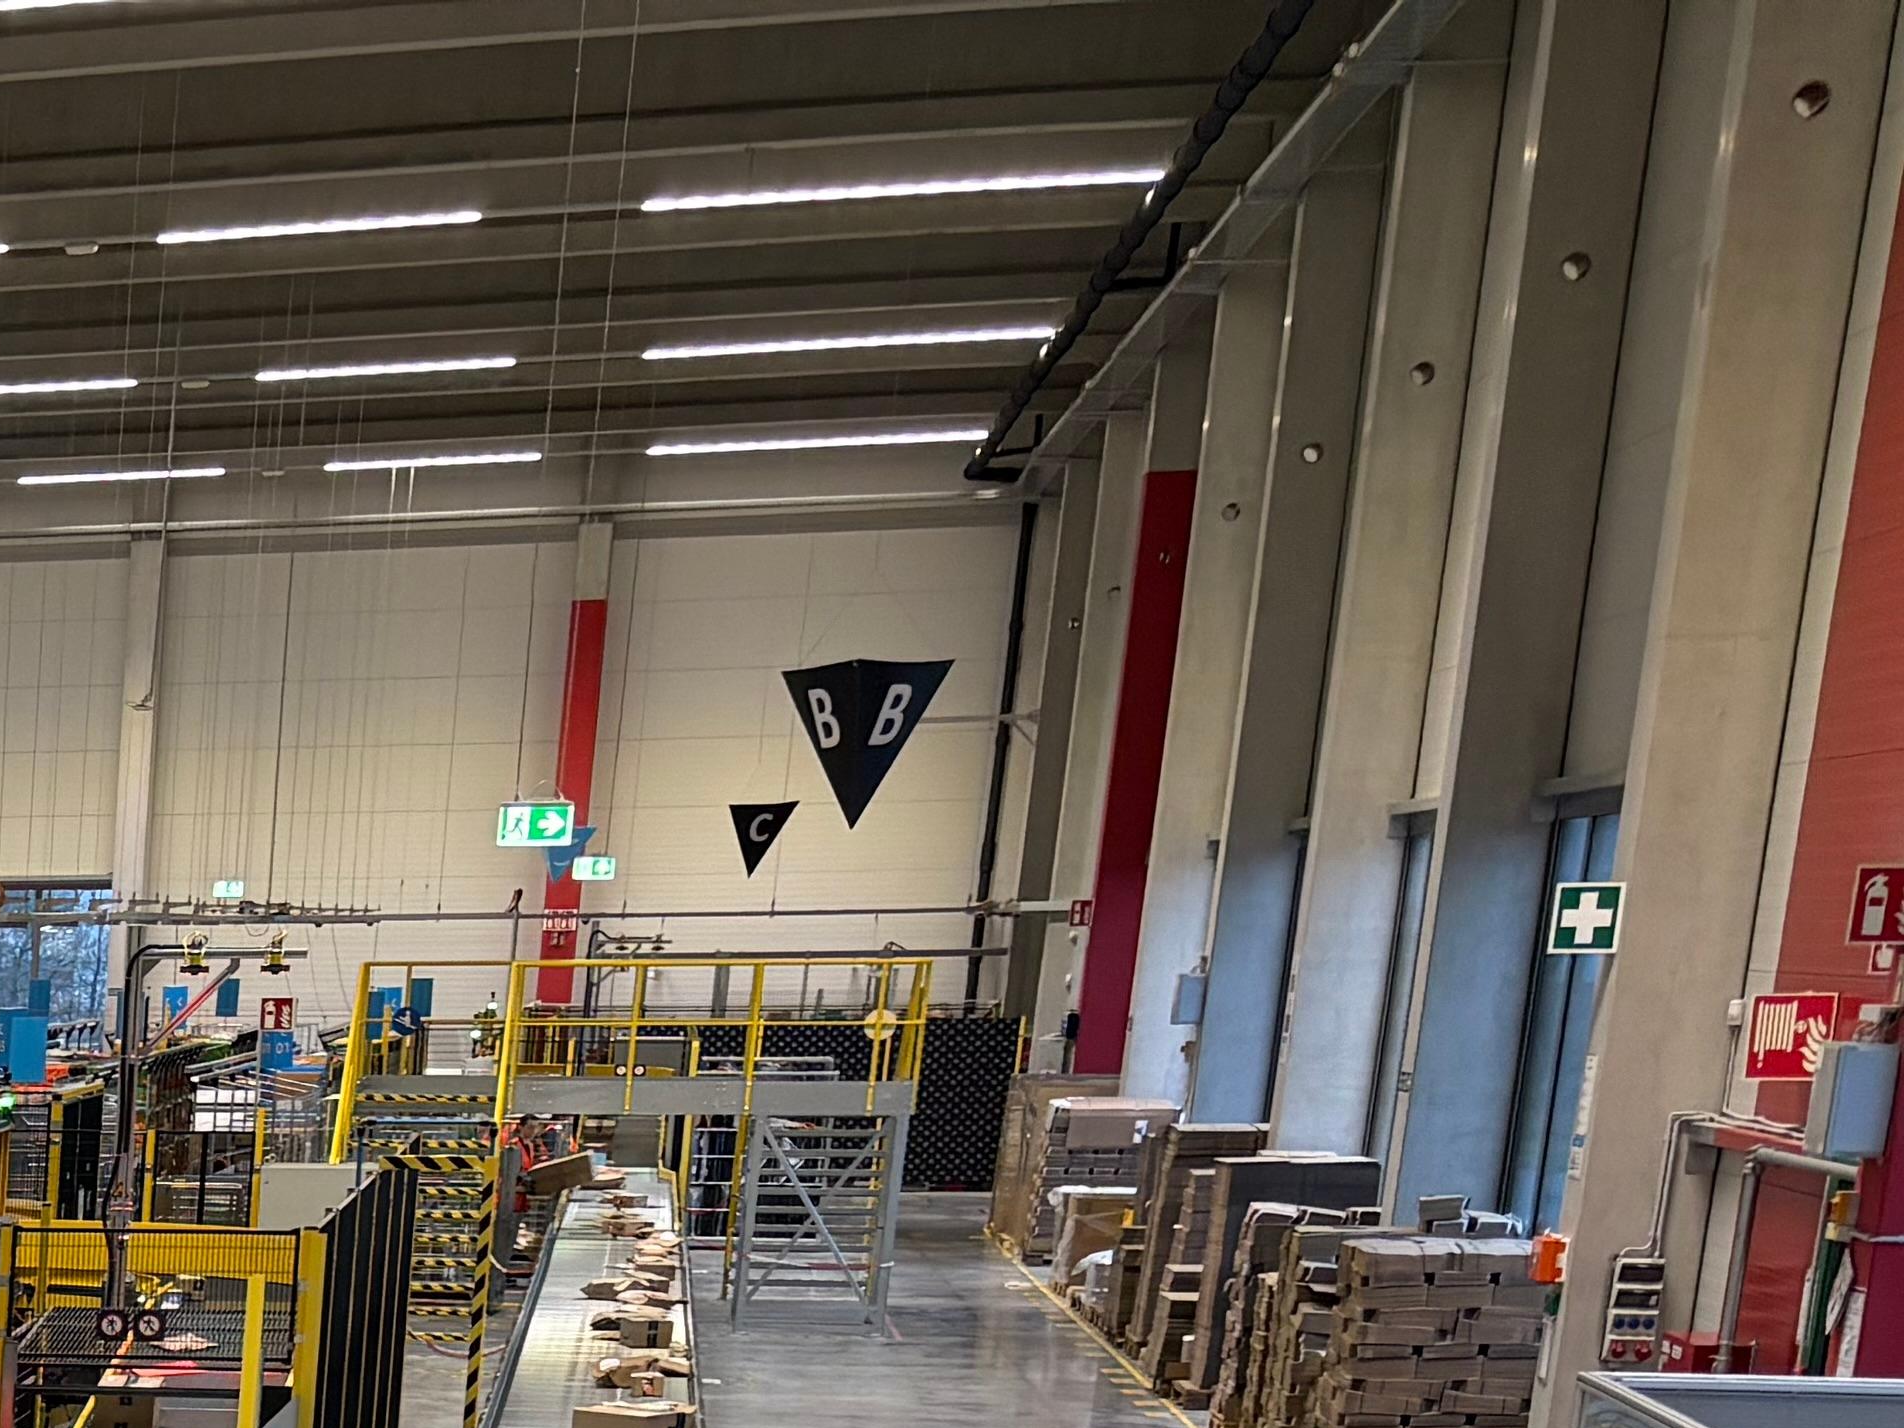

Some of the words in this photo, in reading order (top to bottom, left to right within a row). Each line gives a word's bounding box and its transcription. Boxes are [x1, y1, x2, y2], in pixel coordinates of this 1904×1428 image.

[807, 687, 841, 749] B
[868, 684, 912, 745] B
[749, 813, 773, 843] C
[275, 1043, 290, 1054] 01
